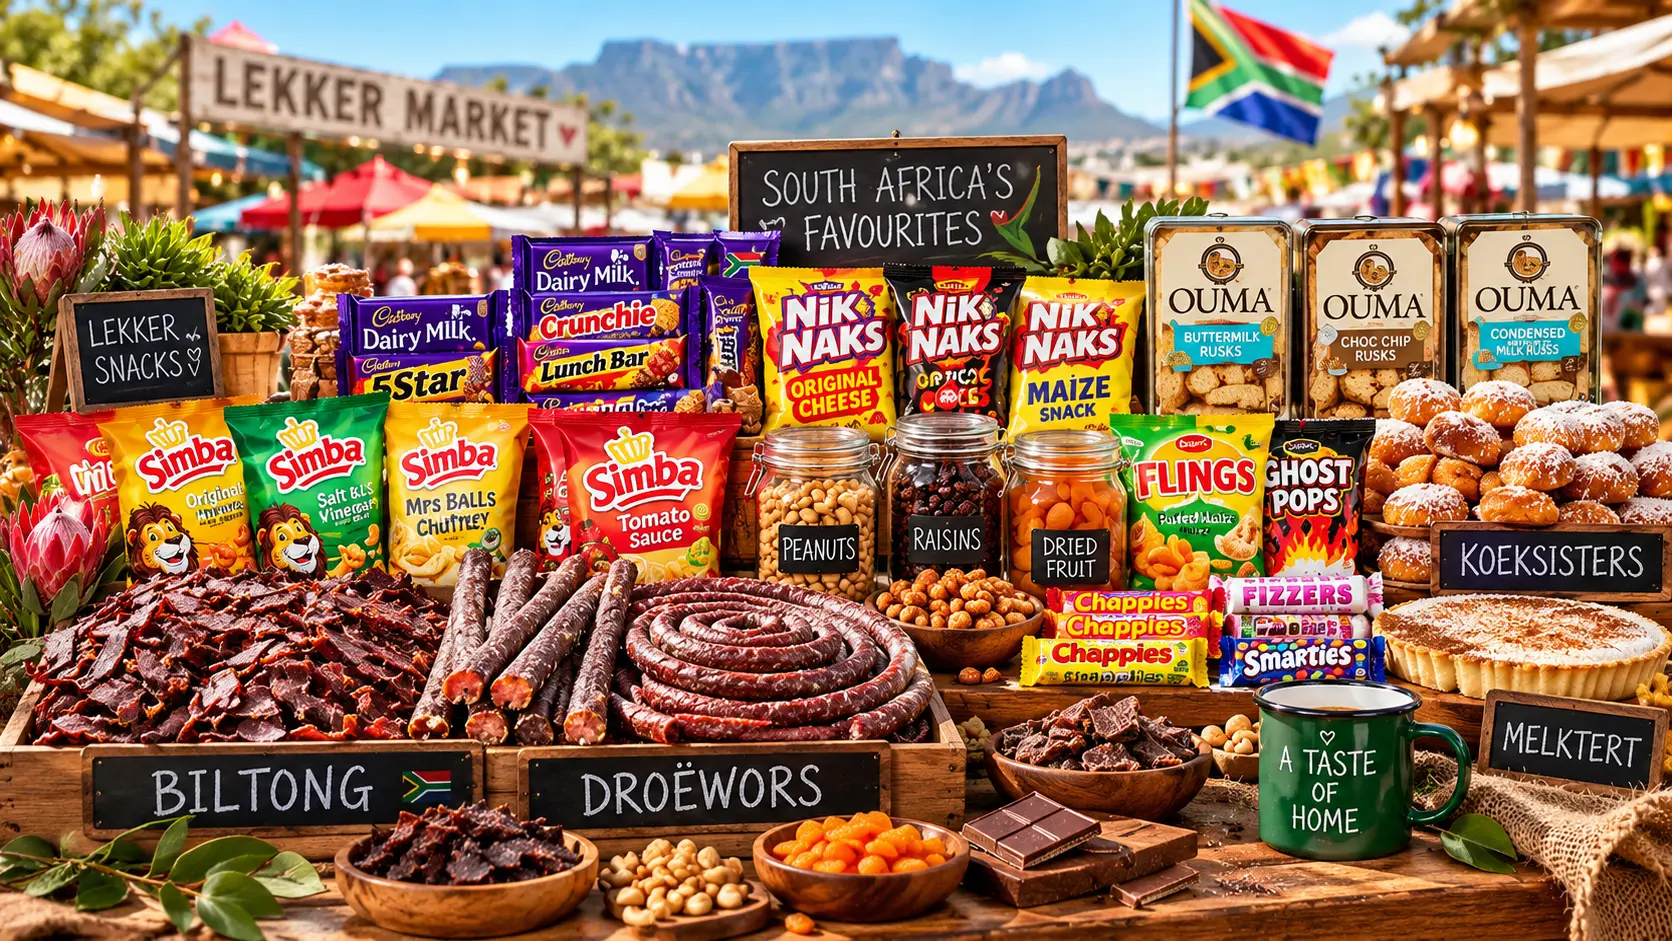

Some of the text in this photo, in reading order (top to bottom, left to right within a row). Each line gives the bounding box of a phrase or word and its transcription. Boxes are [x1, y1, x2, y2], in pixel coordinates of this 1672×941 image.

[214, 57, 550, 149] LEKKER MARKET
[762, 163, 1014, 207] SOUTH AFRICA'S
[803, 210, 983, 251] FAVOURITES
[536, 271, 590, 292] Dairy
[1169, 287, 1274, 314] OUMA
[1323, 293, 1426, 319] OUMA
[1475, 285, 1581, 312] OUMA
[88, 313, 180, 347] LEKKER
[539, 300, 657, 339] Crunchie
[1490, 327, 1566, 339] CONDENSED
[363, 328, 421, 351] Dairy
[780, 320, 884, 367] NAKS
[910, 322, 1001, 361] NAKS
[1023, 328, 1118, 365] NAKS
[1184, 331, 1260, 343] BUTTERMILK
[1200, 345, 1242, 358] RUSKS
[1341, 335, 1411, 348] CHOC CHIP
[95, 350, 183, 384] SNACKS
[540, 350, 650, 382] Lunch Bar
[1355, 349, 1397, 362] RUSKS
[372, 367, 467, 401] 5Star
[790, 369, 878, 399] ORIGINAL
[799, 388, 872, 418] CHEESE
[1040, 402, 1096, 423] SNACK
[137, 436, 236, 491] Simba
[268, 436, 364, 491] Simba
[400, 438, 496, 488] Simba
[1265, 459, 1352, 488] GHOST
[585, 453, 701, 508] Simba
[1136, 460, 1255, 498] FLINGS
[1272, 487, 1339, 514] POPS
[616, 506, 691, 533] Tomato
[629, 526, 684, 549] Sauce
[782, 536, 855, 561] PEANUTS
[914, 527, 981, 551] RAISINS
[1043, 536, 1098, 557] DRIED
[1046, 559, 1097, 578] FRUIT
[1461, 542, 1644, 578] KOEKSISTERS
[1074, 593, 1188, 614] Chappies
[1243, 584, 1353, 607] FIZZERS
[1065, 615, 1187, 640] Chappies
[1051, 642, 1173, 667] Chappies
[1244, 644, 1352, 677] Smarties
[1502, 721, 1643, 768] MELKTERT
[1279, 745, 1377, 777] A TASTE
[151, 764, 374, 816] BILTONG
[581, 761, 822, 817] DROËWORS
[1311, 782, 1339, 803] OF
[1292, 803, 1359, 834] HOME
